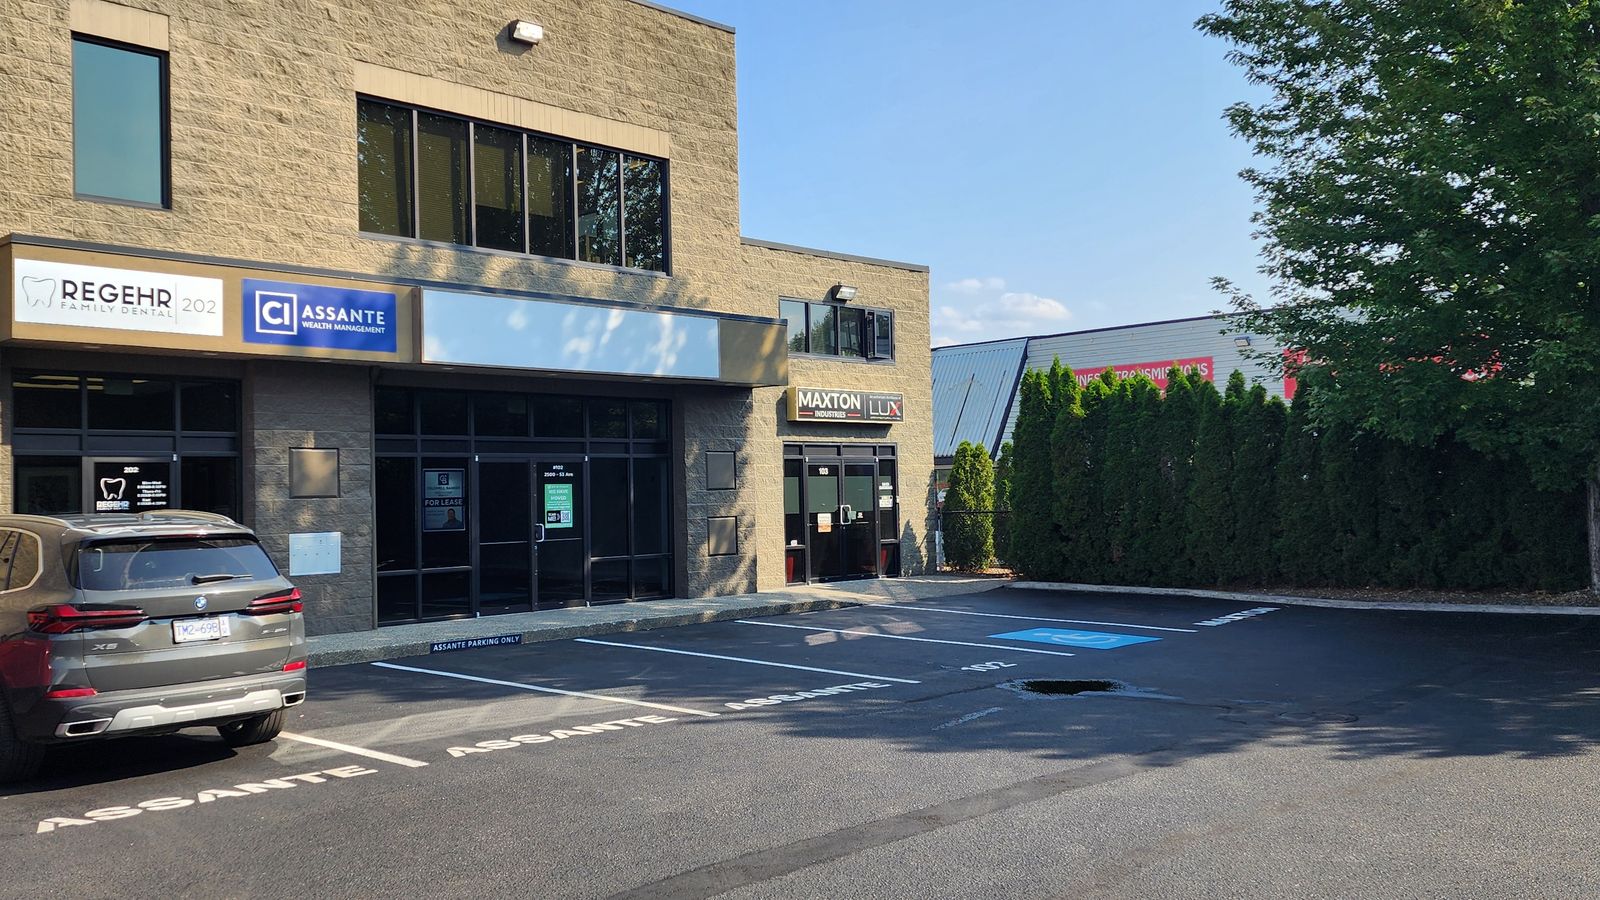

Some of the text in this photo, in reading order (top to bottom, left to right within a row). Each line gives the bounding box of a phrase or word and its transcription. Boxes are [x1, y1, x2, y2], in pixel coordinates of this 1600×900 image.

[61, 279, 172, 308] REGEHR
[61, 301, 173, 318] FAMILY DENTAL
[182, 298, 216, 313] 202
[262, 300, 291, 325] CI
[301, 304, 385, 325] ASSANTE
[301, 320, 386, 334] WEALTH MANAGEMENT
[798, 391, 861, 410] MAXTON
[869, 399, 901, 416] LUX
[814, 410, 846, 418] INDUSTRIES
[818, 467, 829, 475] 103
[433, 635, 520, 651] ASSANTE PARKING ONLY
[960, 660, 1017, 673] 102
[724, 681, 891, 712] ASSANTE
[446, 714, 678, 758] ASSANTE
[36, 764, 379, 834] ASSANTE
